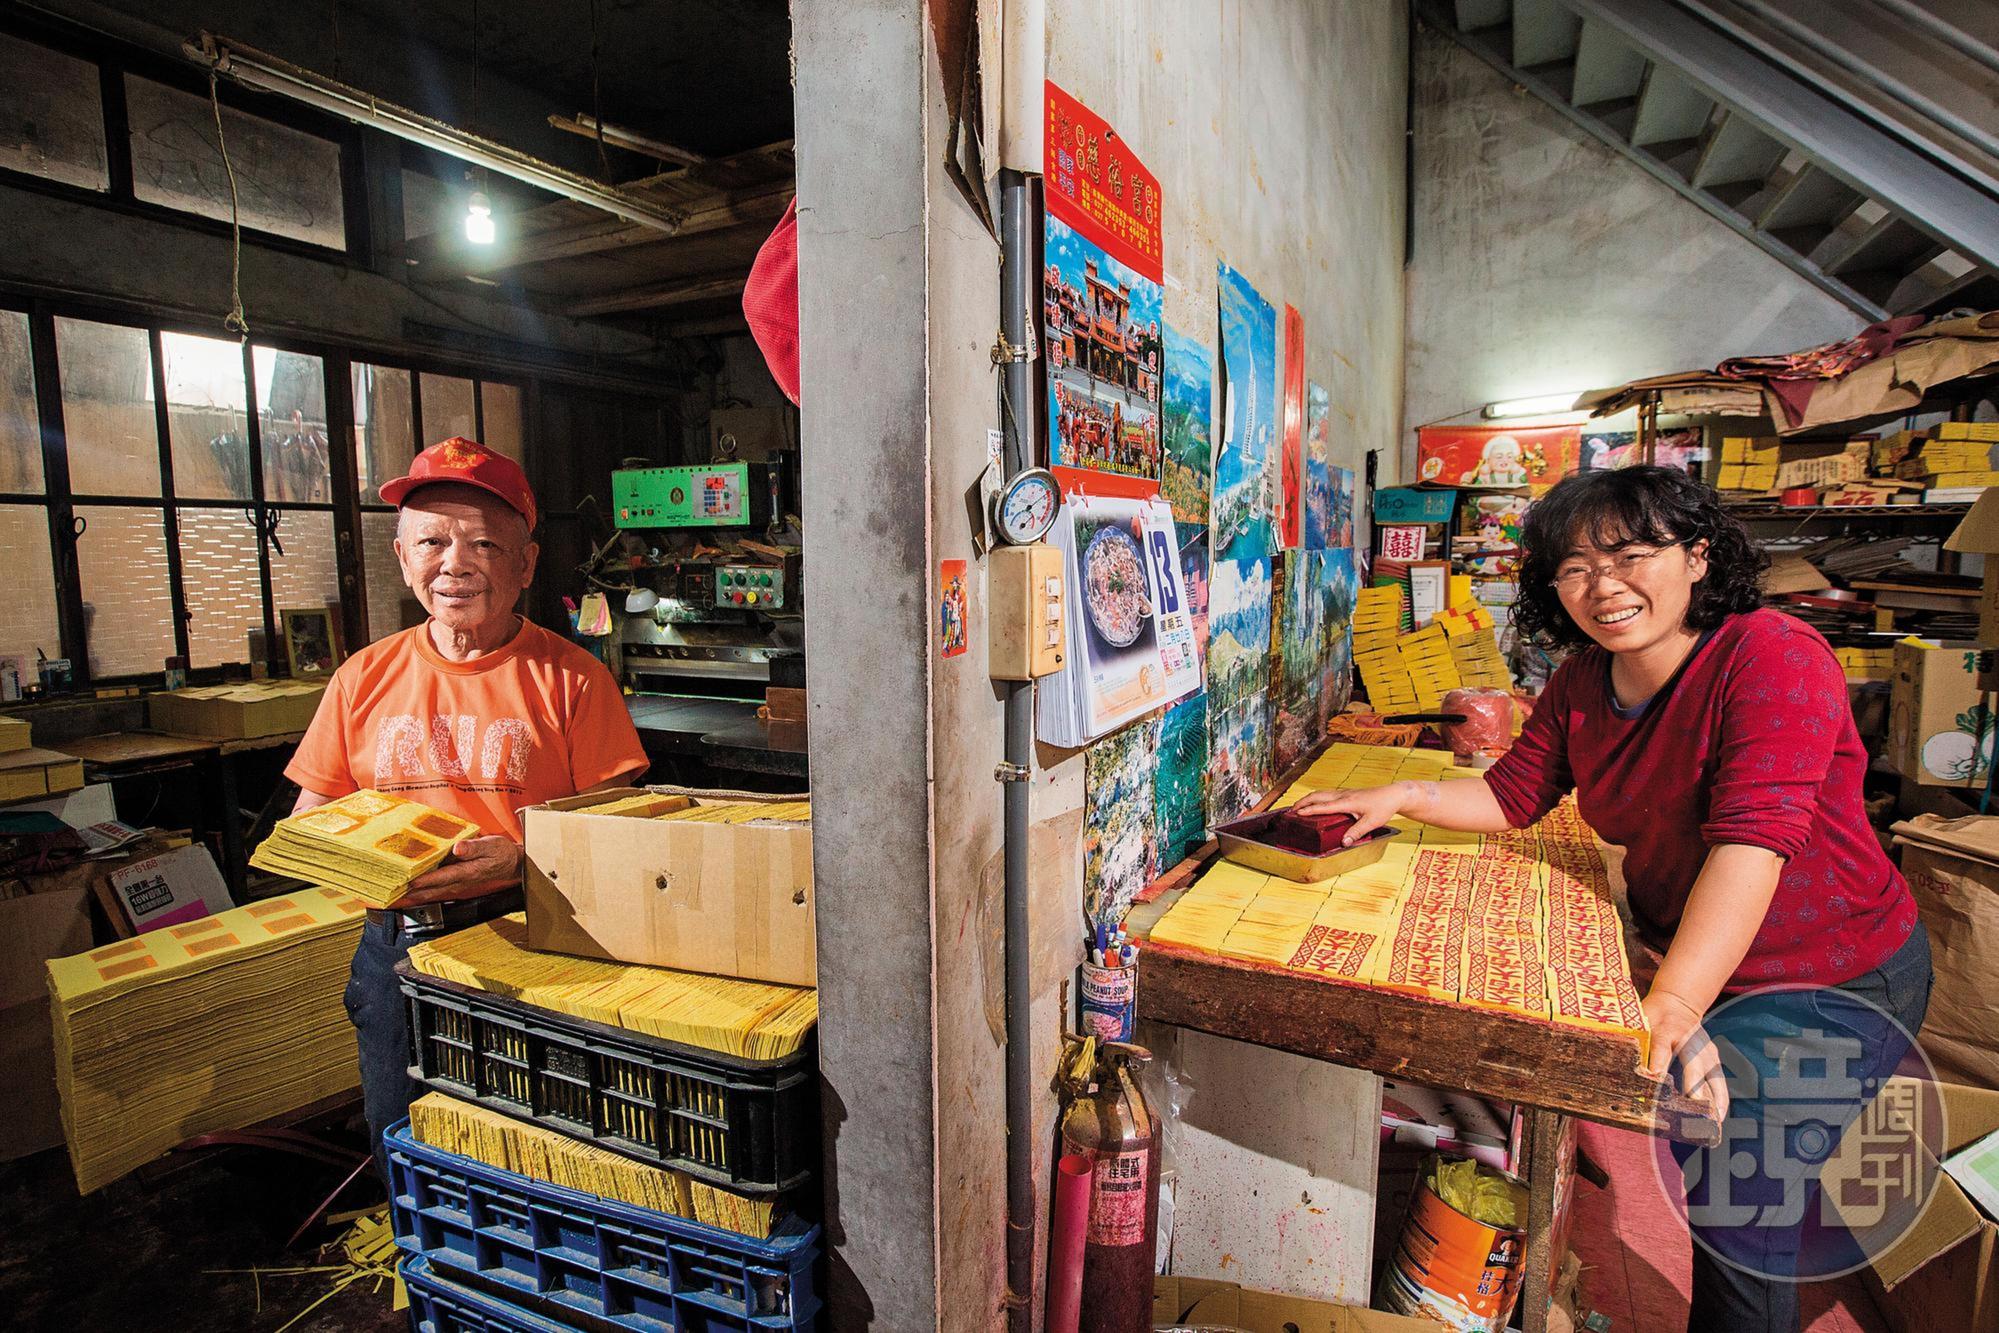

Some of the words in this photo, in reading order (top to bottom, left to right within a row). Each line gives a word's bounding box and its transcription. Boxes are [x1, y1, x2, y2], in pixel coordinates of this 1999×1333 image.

[1148, 531, 1179, 615] 13
[1160, 615, 1184, 633] 星期五
[1090, 982, 1111, 996] PEANUT
[1113, 984, 1129, 996] SOUP
